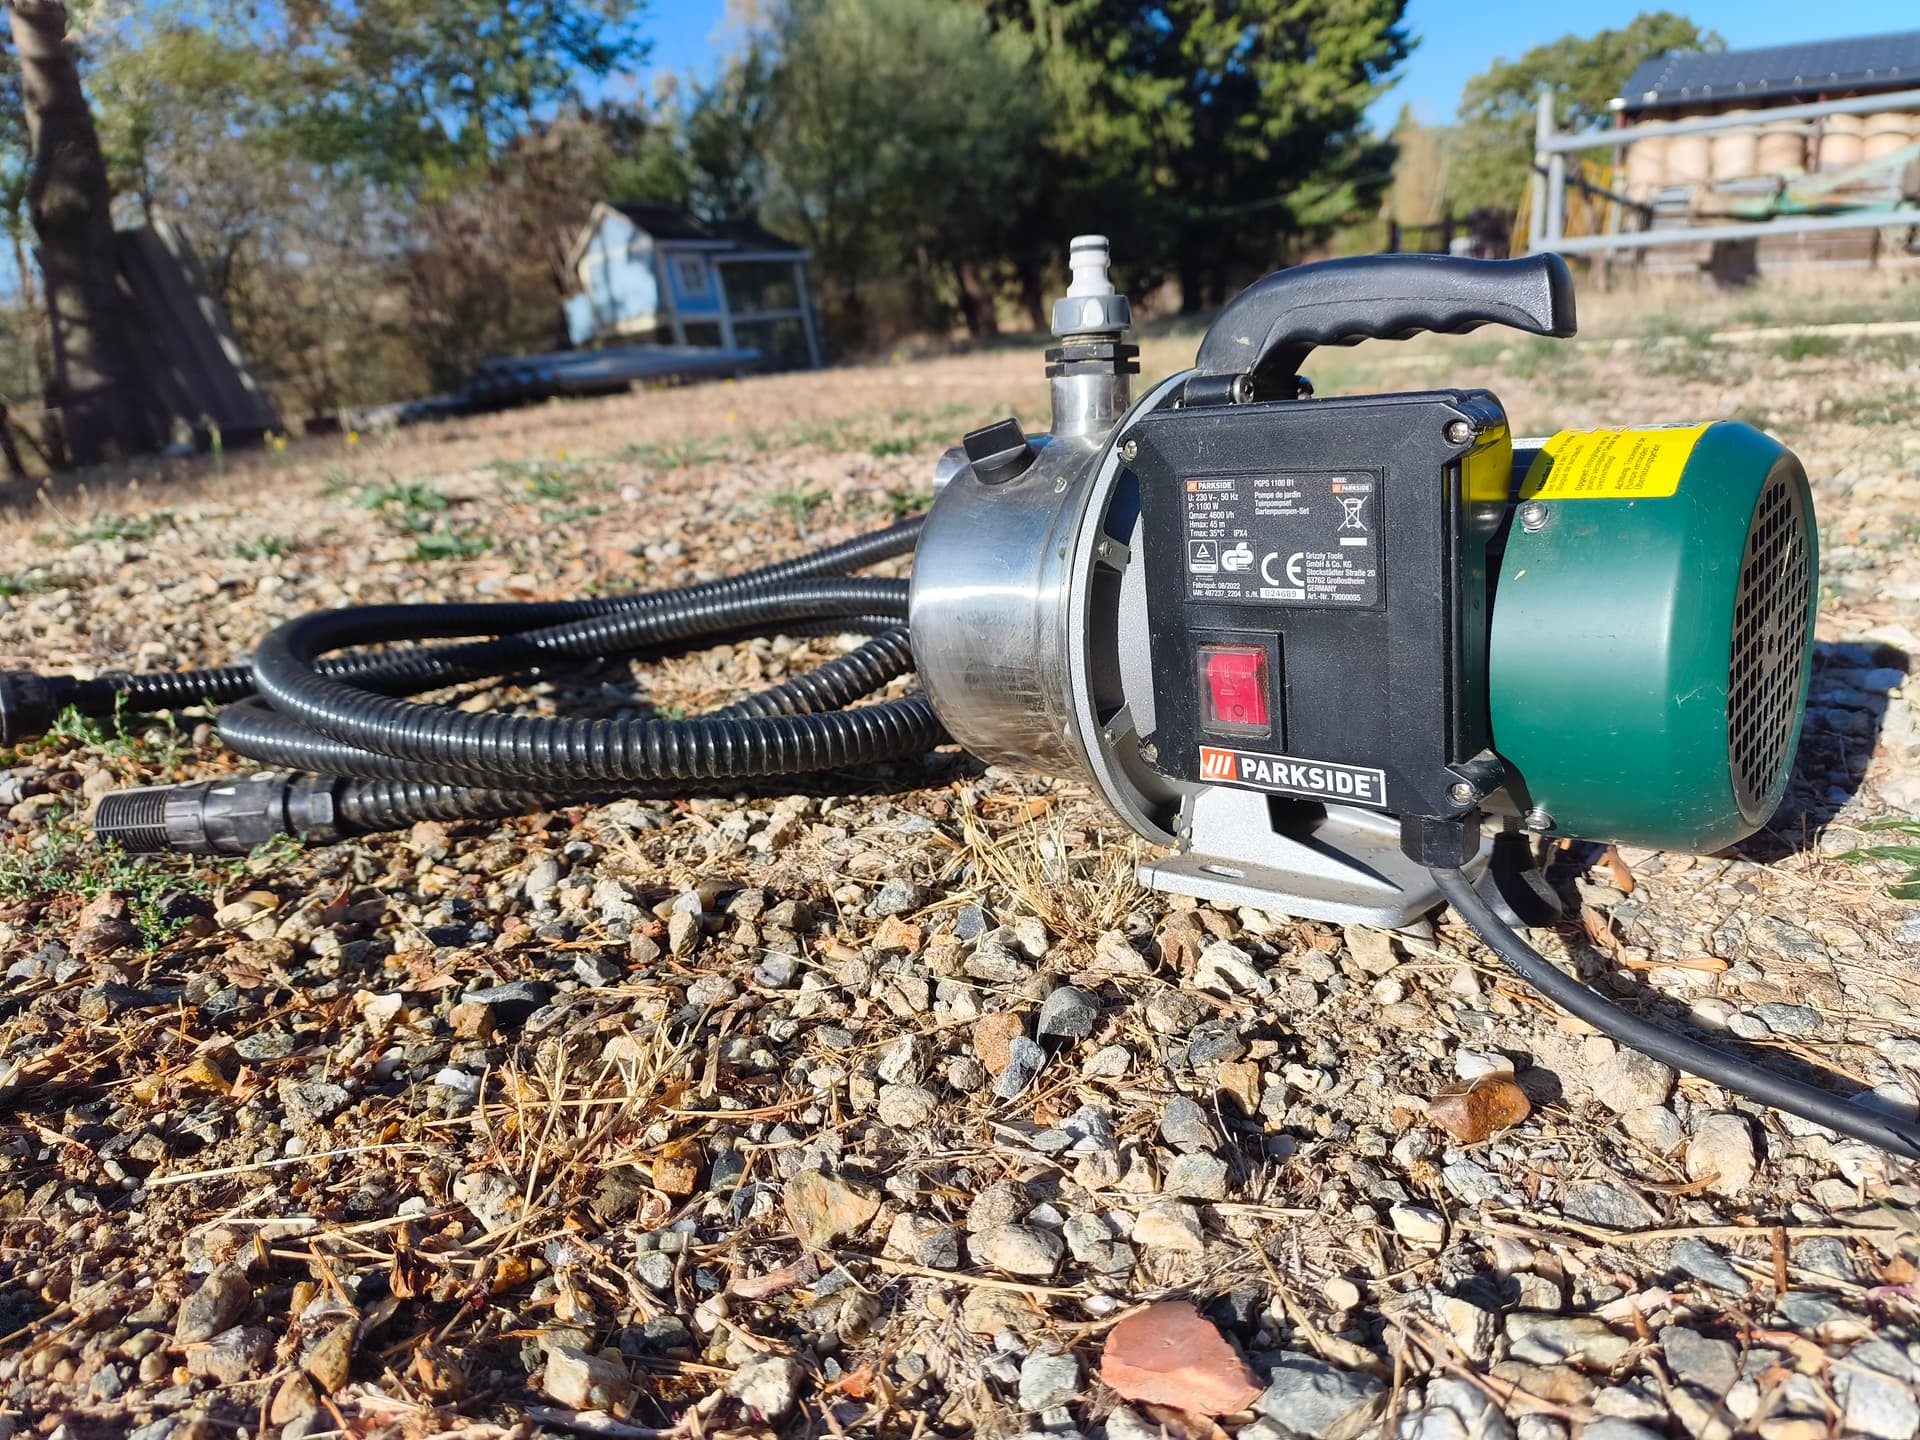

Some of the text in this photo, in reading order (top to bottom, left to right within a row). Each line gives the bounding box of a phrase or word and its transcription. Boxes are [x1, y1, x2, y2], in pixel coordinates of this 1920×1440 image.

[1198, 481, 1232, 490] PARKSIDE
[1253, 479, 1270, 487] PGPS
[1271, 479, 1286, 487] 1100
[1187, 493, 1195, 501] U:
[1196, 493, 1207, 501] 230
[1220, 493, 1228, 501] 50
[1230, 492, 1239, 501] Hz
[1254, 490, 1301, 500] Pompe de jardin
[1188, 502, 1219, 511] P: 1100 W
[1189, 511, 1235, 520] Qmax: 4600 l/h
[1255, 507, 1310, 516] Gartenpumpen-Set
[1189, 520, 1208, 528] Hmax:
[1209, 520, 1218, 528] 45
[1189, 529, 1248, 537] Tmax: 35°C IPX4
[1305, 552, 1344, 560] Grizzly Tools
[1306, 560, 1352, 568] GmbH & Co. KG
[1261, 552, 1305, 587] CE
[1306, 568, 1376, 577] Stockstädter Straße 20
[1307, 576, 1366, 585] 63762 Großostheim
[1307, 584, 1337, 592] GERMANY
[1241, 757, 1373, 798] PARKSIDE
